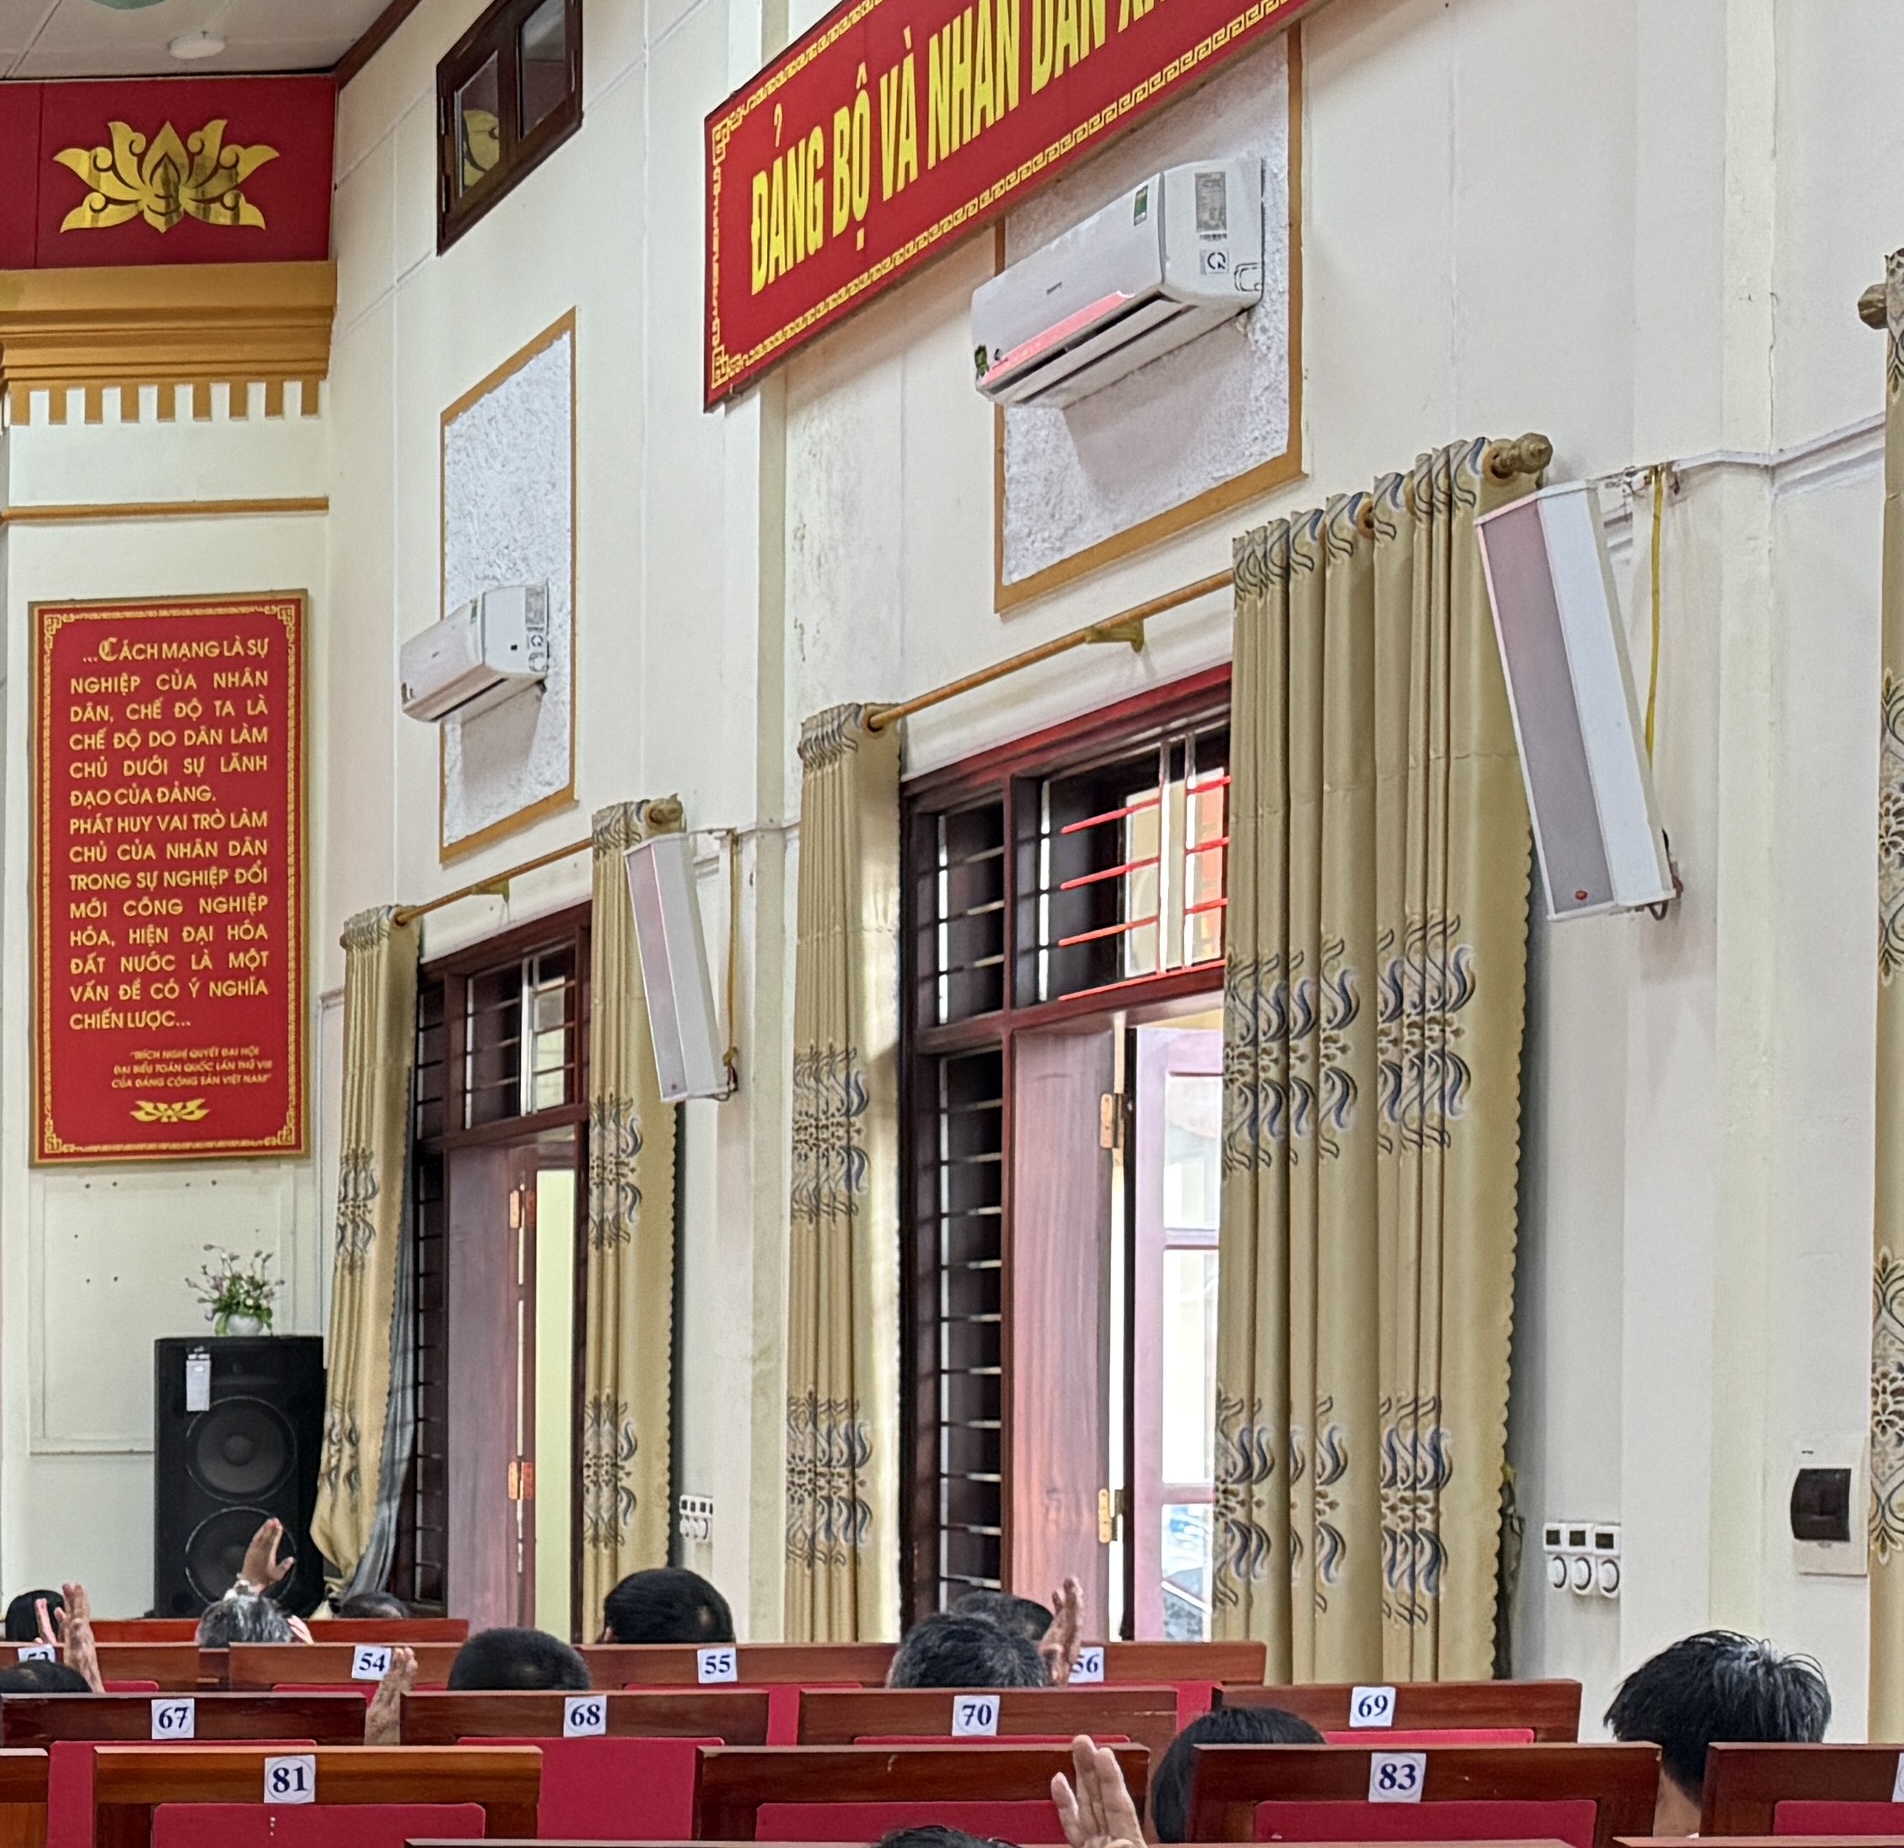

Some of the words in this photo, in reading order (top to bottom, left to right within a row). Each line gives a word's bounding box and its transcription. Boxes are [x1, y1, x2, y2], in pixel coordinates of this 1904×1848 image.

[749, 102, 823, 294] ĐẢNG
[833, 63, 870, 250] BỘ
[880, 26, 917, 201] VÀ
[161, 640, 221, 661] MẠNG
[223, 635, 245, 657] LÀ
[246, 638, 270, 659] SỰ
[70, 672, 141, 697] NGHIỆP
[155, 668, 198, 691] CỦA
[213, 667, 269, 689] NHÂN
[70, 701, 114, 723] DÂN,
[125, 697, 163, 721] CHẾ
[173, 697, 203, 722] ĐỘ
[213, 700, 236, 717] TA
[246, 694, 269, 716] LÀ
[69, 789, 112, 810] ĐẠO
[113, 782, 154, 806] CỦA
[156, 781, 217, 803] ĐẢNG.
[69, 839, 108, 863] CHỦ
[116, 838, 157, 862] CỦA
[166, 838, 219, 859] NHÂN
[228, 836, 268, 857] DÂN
[122, 895, 184, 917] CÔNG
[199, 892, 269, 916] NGHIỆP
[128, 924, 169, 947] HIỆN
[181, 925, 214, 946] ĐẠI
[359, 1653, 386, 1673] 54
[705, 1655, 730, 1674] 55
[159, 1707, 188, 1728] 67
[571, 1704, 600, 1726] 68
[963, 1705, 991, 1725] 70
[1359, 1695, 1388, 1717] 69
[273, 1767, 306, 1793] 81
[1379, 1764, 1416, 1790] 83
